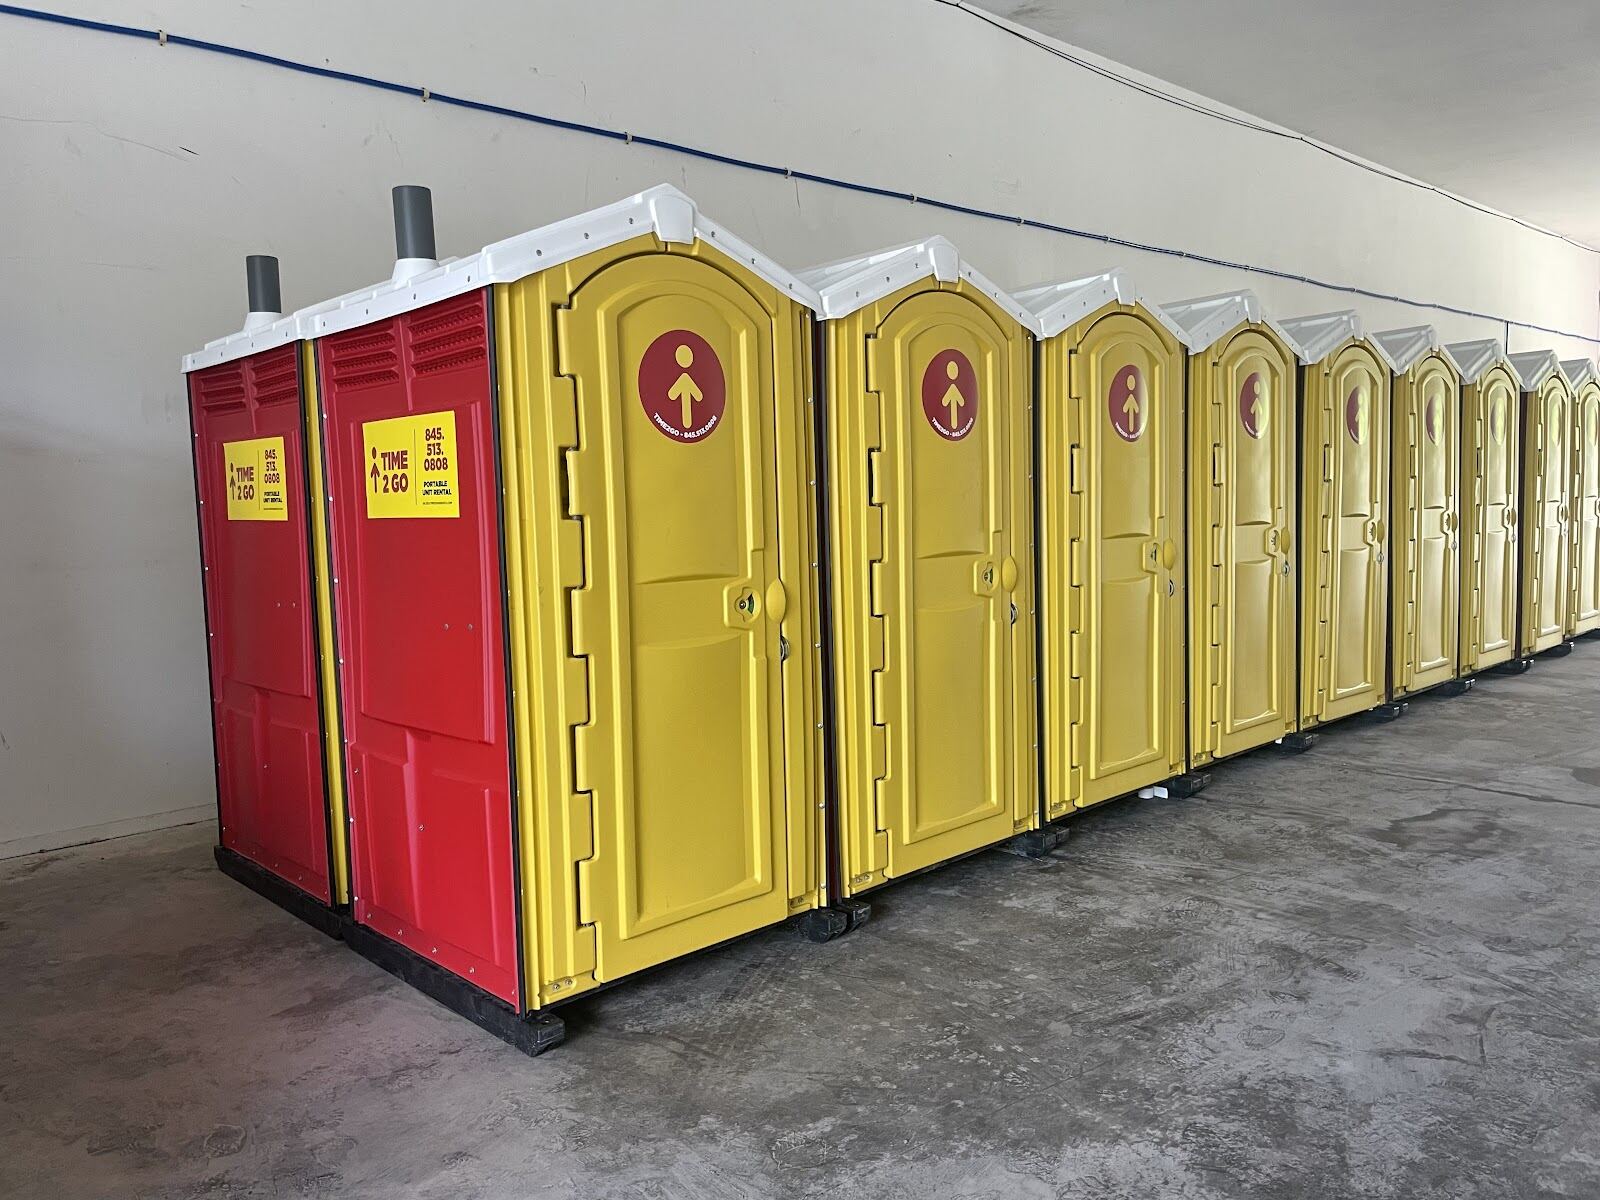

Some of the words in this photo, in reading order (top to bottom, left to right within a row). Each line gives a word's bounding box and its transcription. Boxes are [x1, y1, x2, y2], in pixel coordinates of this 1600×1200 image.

[653, 412, 679, 436] TIME2GO
[425, 427, 444, 441] 845.
[264, 449, 277, 460] 845.
[427, 443, 444, 456] 513.
[266, 461, 277, 472] 513.
[381, 450, 408, 471] TIME
[424, 457, 448, 471] 0808
[236, 466, 254, 482] TIME
[383, 474, 389, 493] 2
[391, 473, 408, 493] GO
[237, 485, 242, 500] 2
[243, 484, 254, 500] GO
